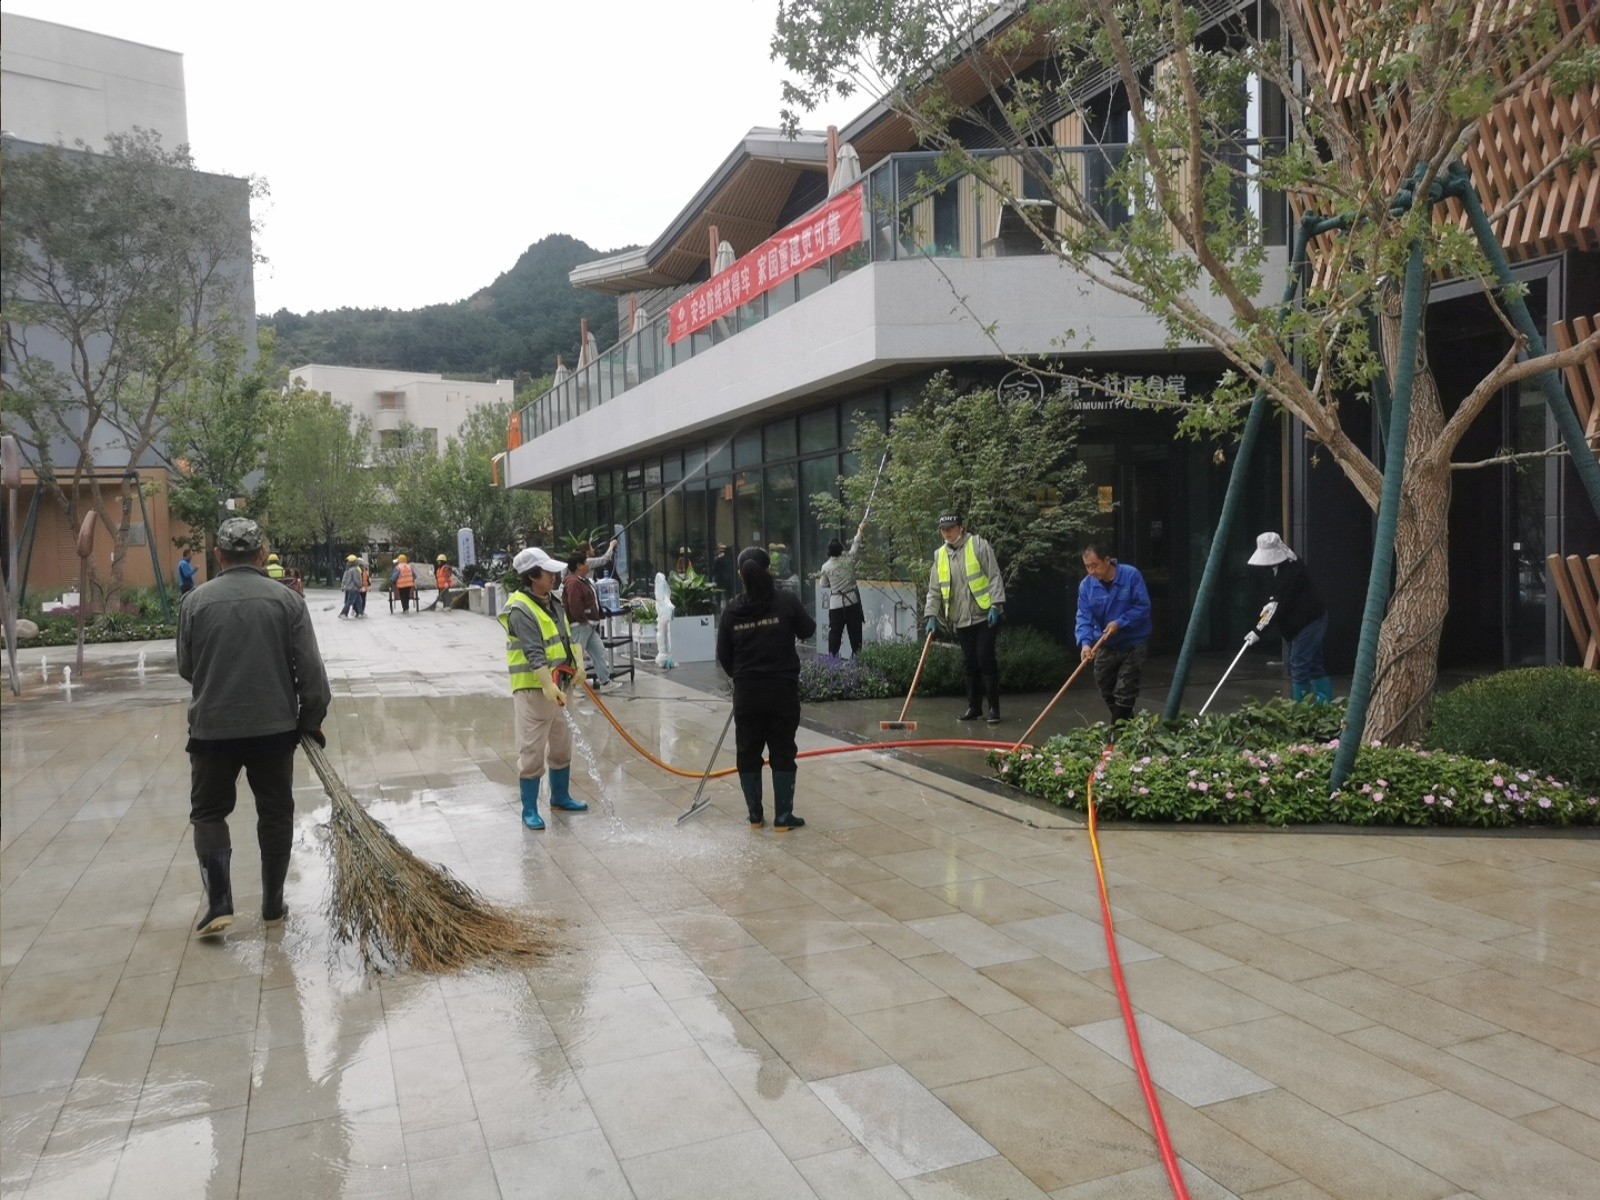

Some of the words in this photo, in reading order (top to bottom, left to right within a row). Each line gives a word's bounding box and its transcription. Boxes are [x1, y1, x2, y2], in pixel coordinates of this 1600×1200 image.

[757, 210, 841, 286] 家园重建更可靠
